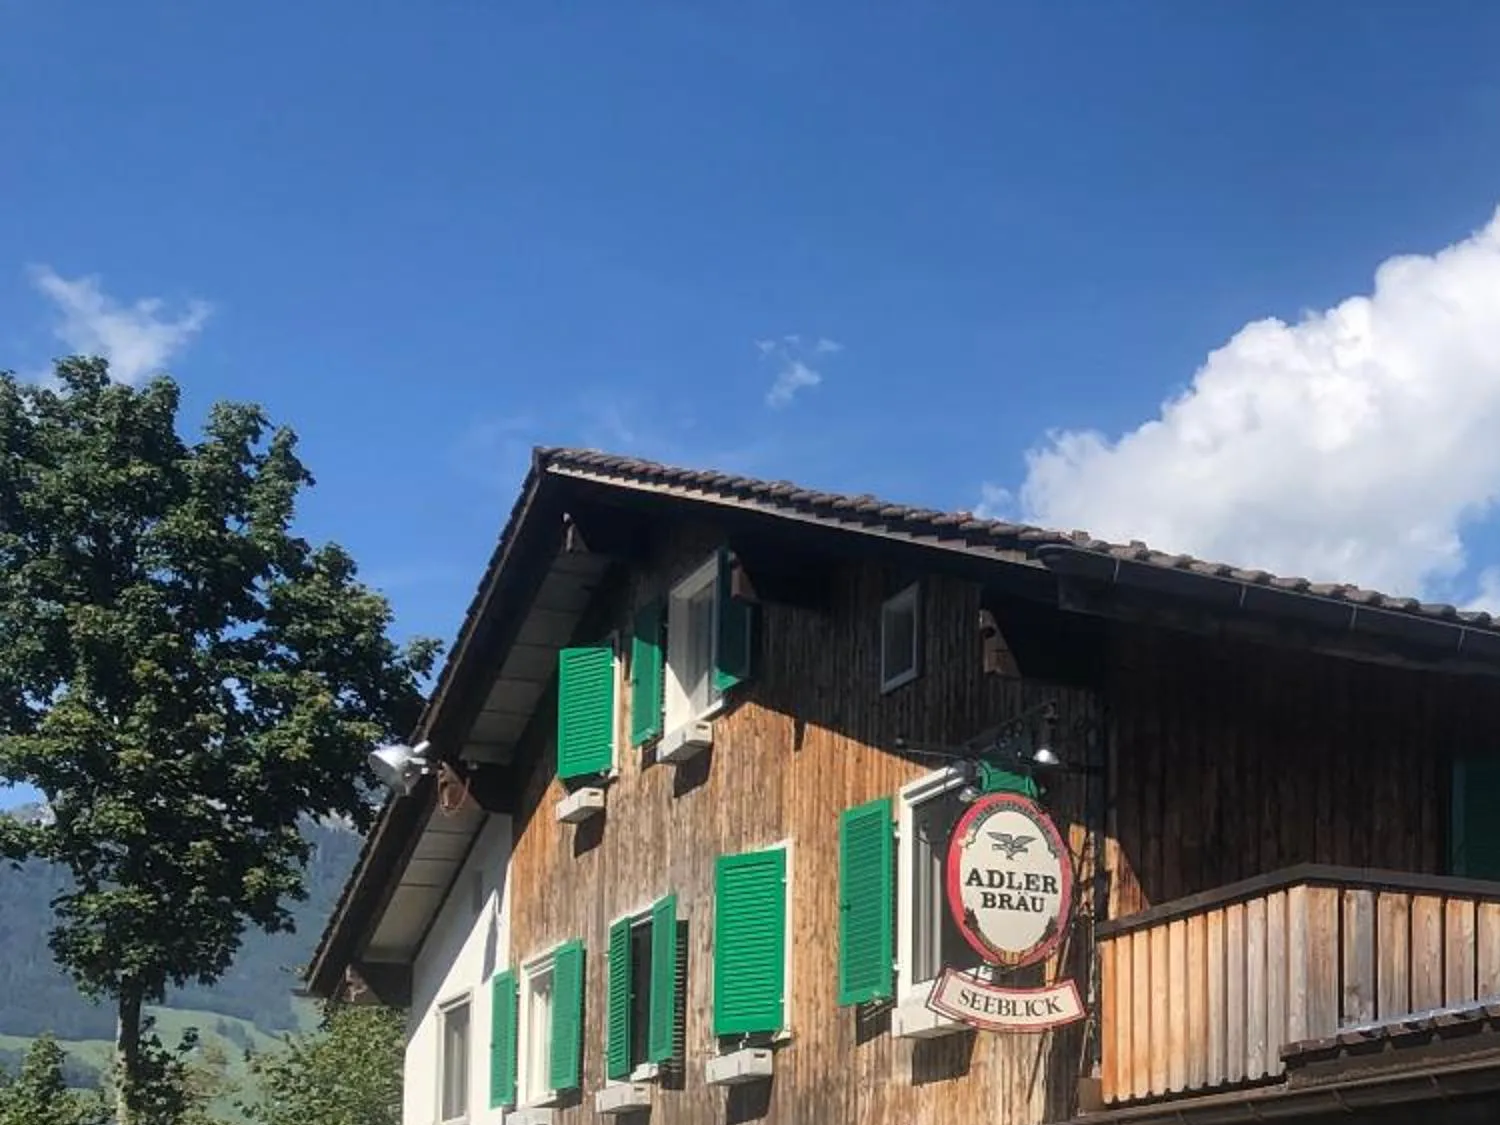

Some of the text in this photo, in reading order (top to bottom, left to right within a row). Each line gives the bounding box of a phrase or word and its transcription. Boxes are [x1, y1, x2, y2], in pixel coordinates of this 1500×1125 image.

[965, 867, 1059, 895] ADLER
[980, 889, 1046, 914] BRÄU
[958, 987, 1064, 1018] SEEBLICK
